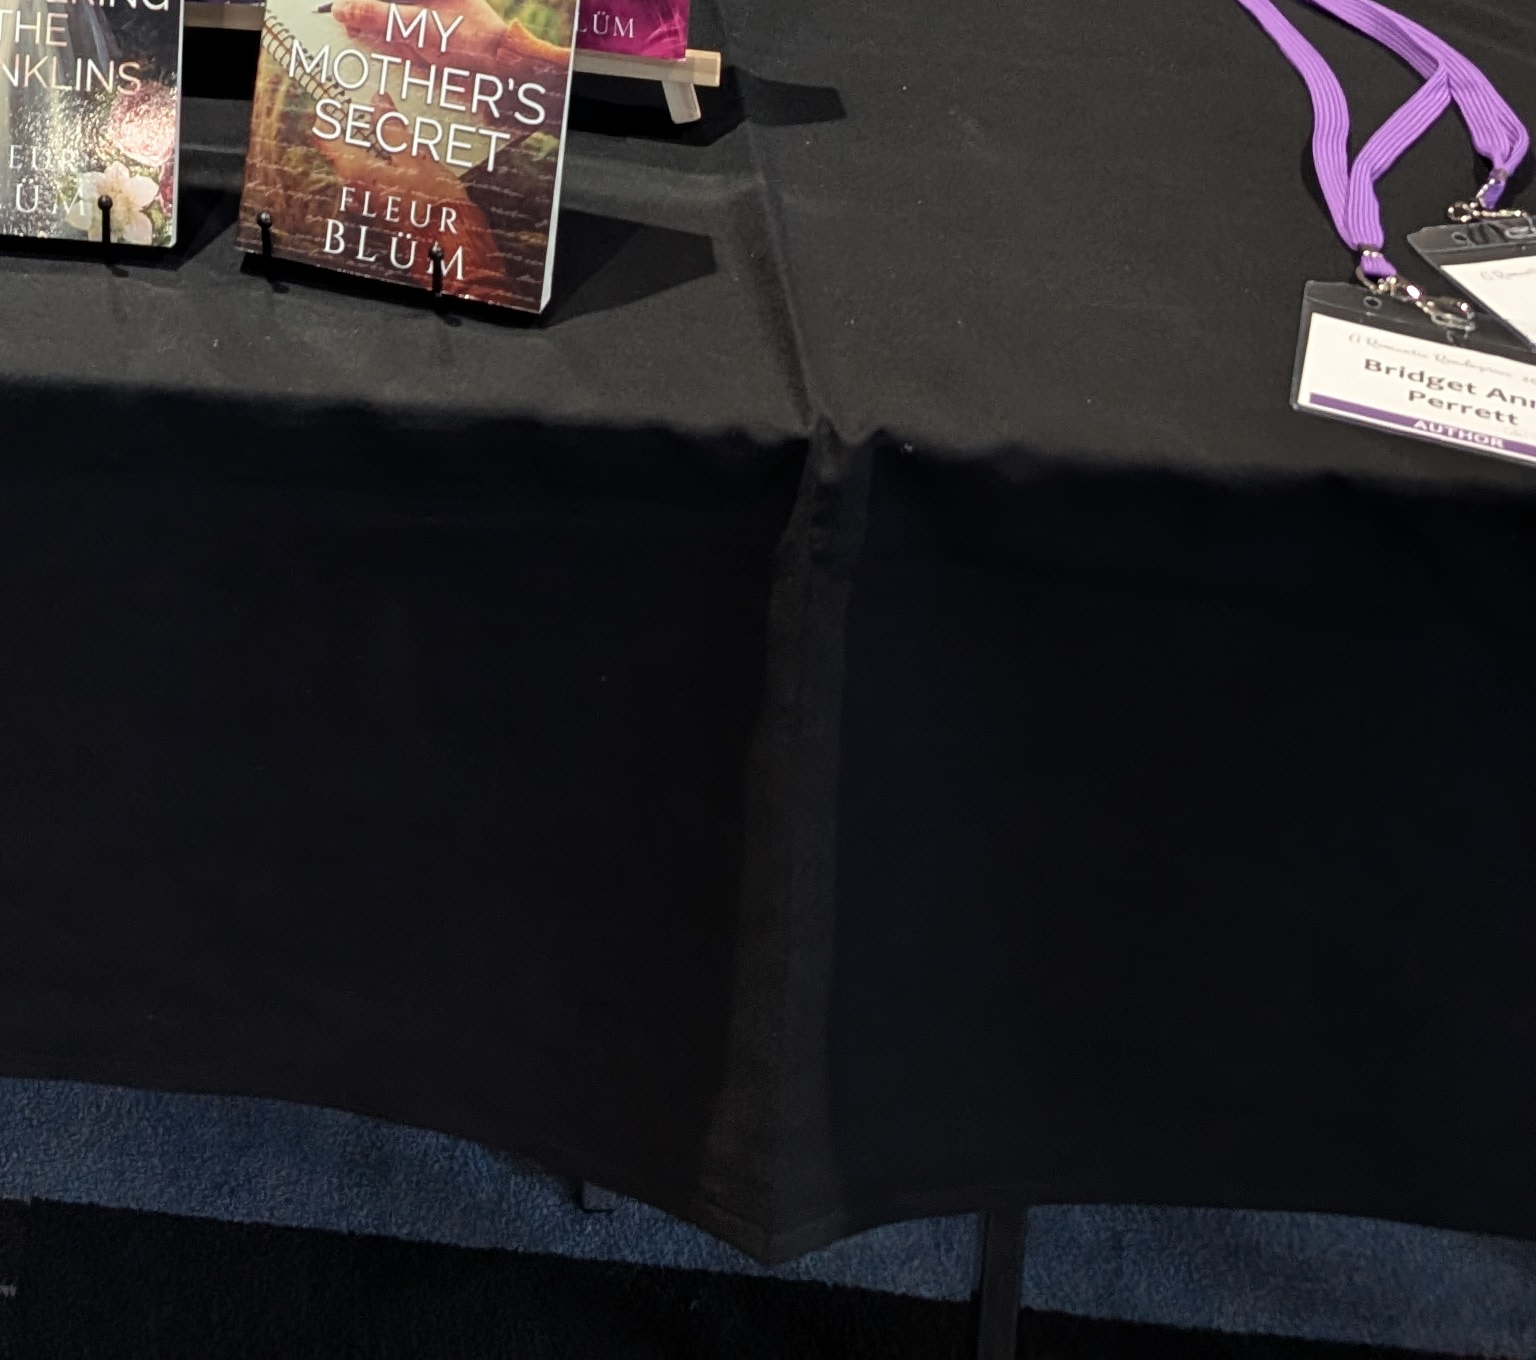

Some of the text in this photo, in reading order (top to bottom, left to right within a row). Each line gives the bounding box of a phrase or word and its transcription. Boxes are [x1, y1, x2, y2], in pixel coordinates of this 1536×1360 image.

[385, 3, 464, 53] MY
[576, 10, 634, 39] LÜM
[288, 39, 547, 125] MOTHER'S
[312, 99, 511, 173] SECRET
[339, 186, 459, 235] FLEUR
[323, 218, 465, 281] BLÜM
[1364, 358, 1477, 395] Bridget
[1408, 389, 1518, 426] Perrett
[1414, 419, 1504, 449] AUTHOR
